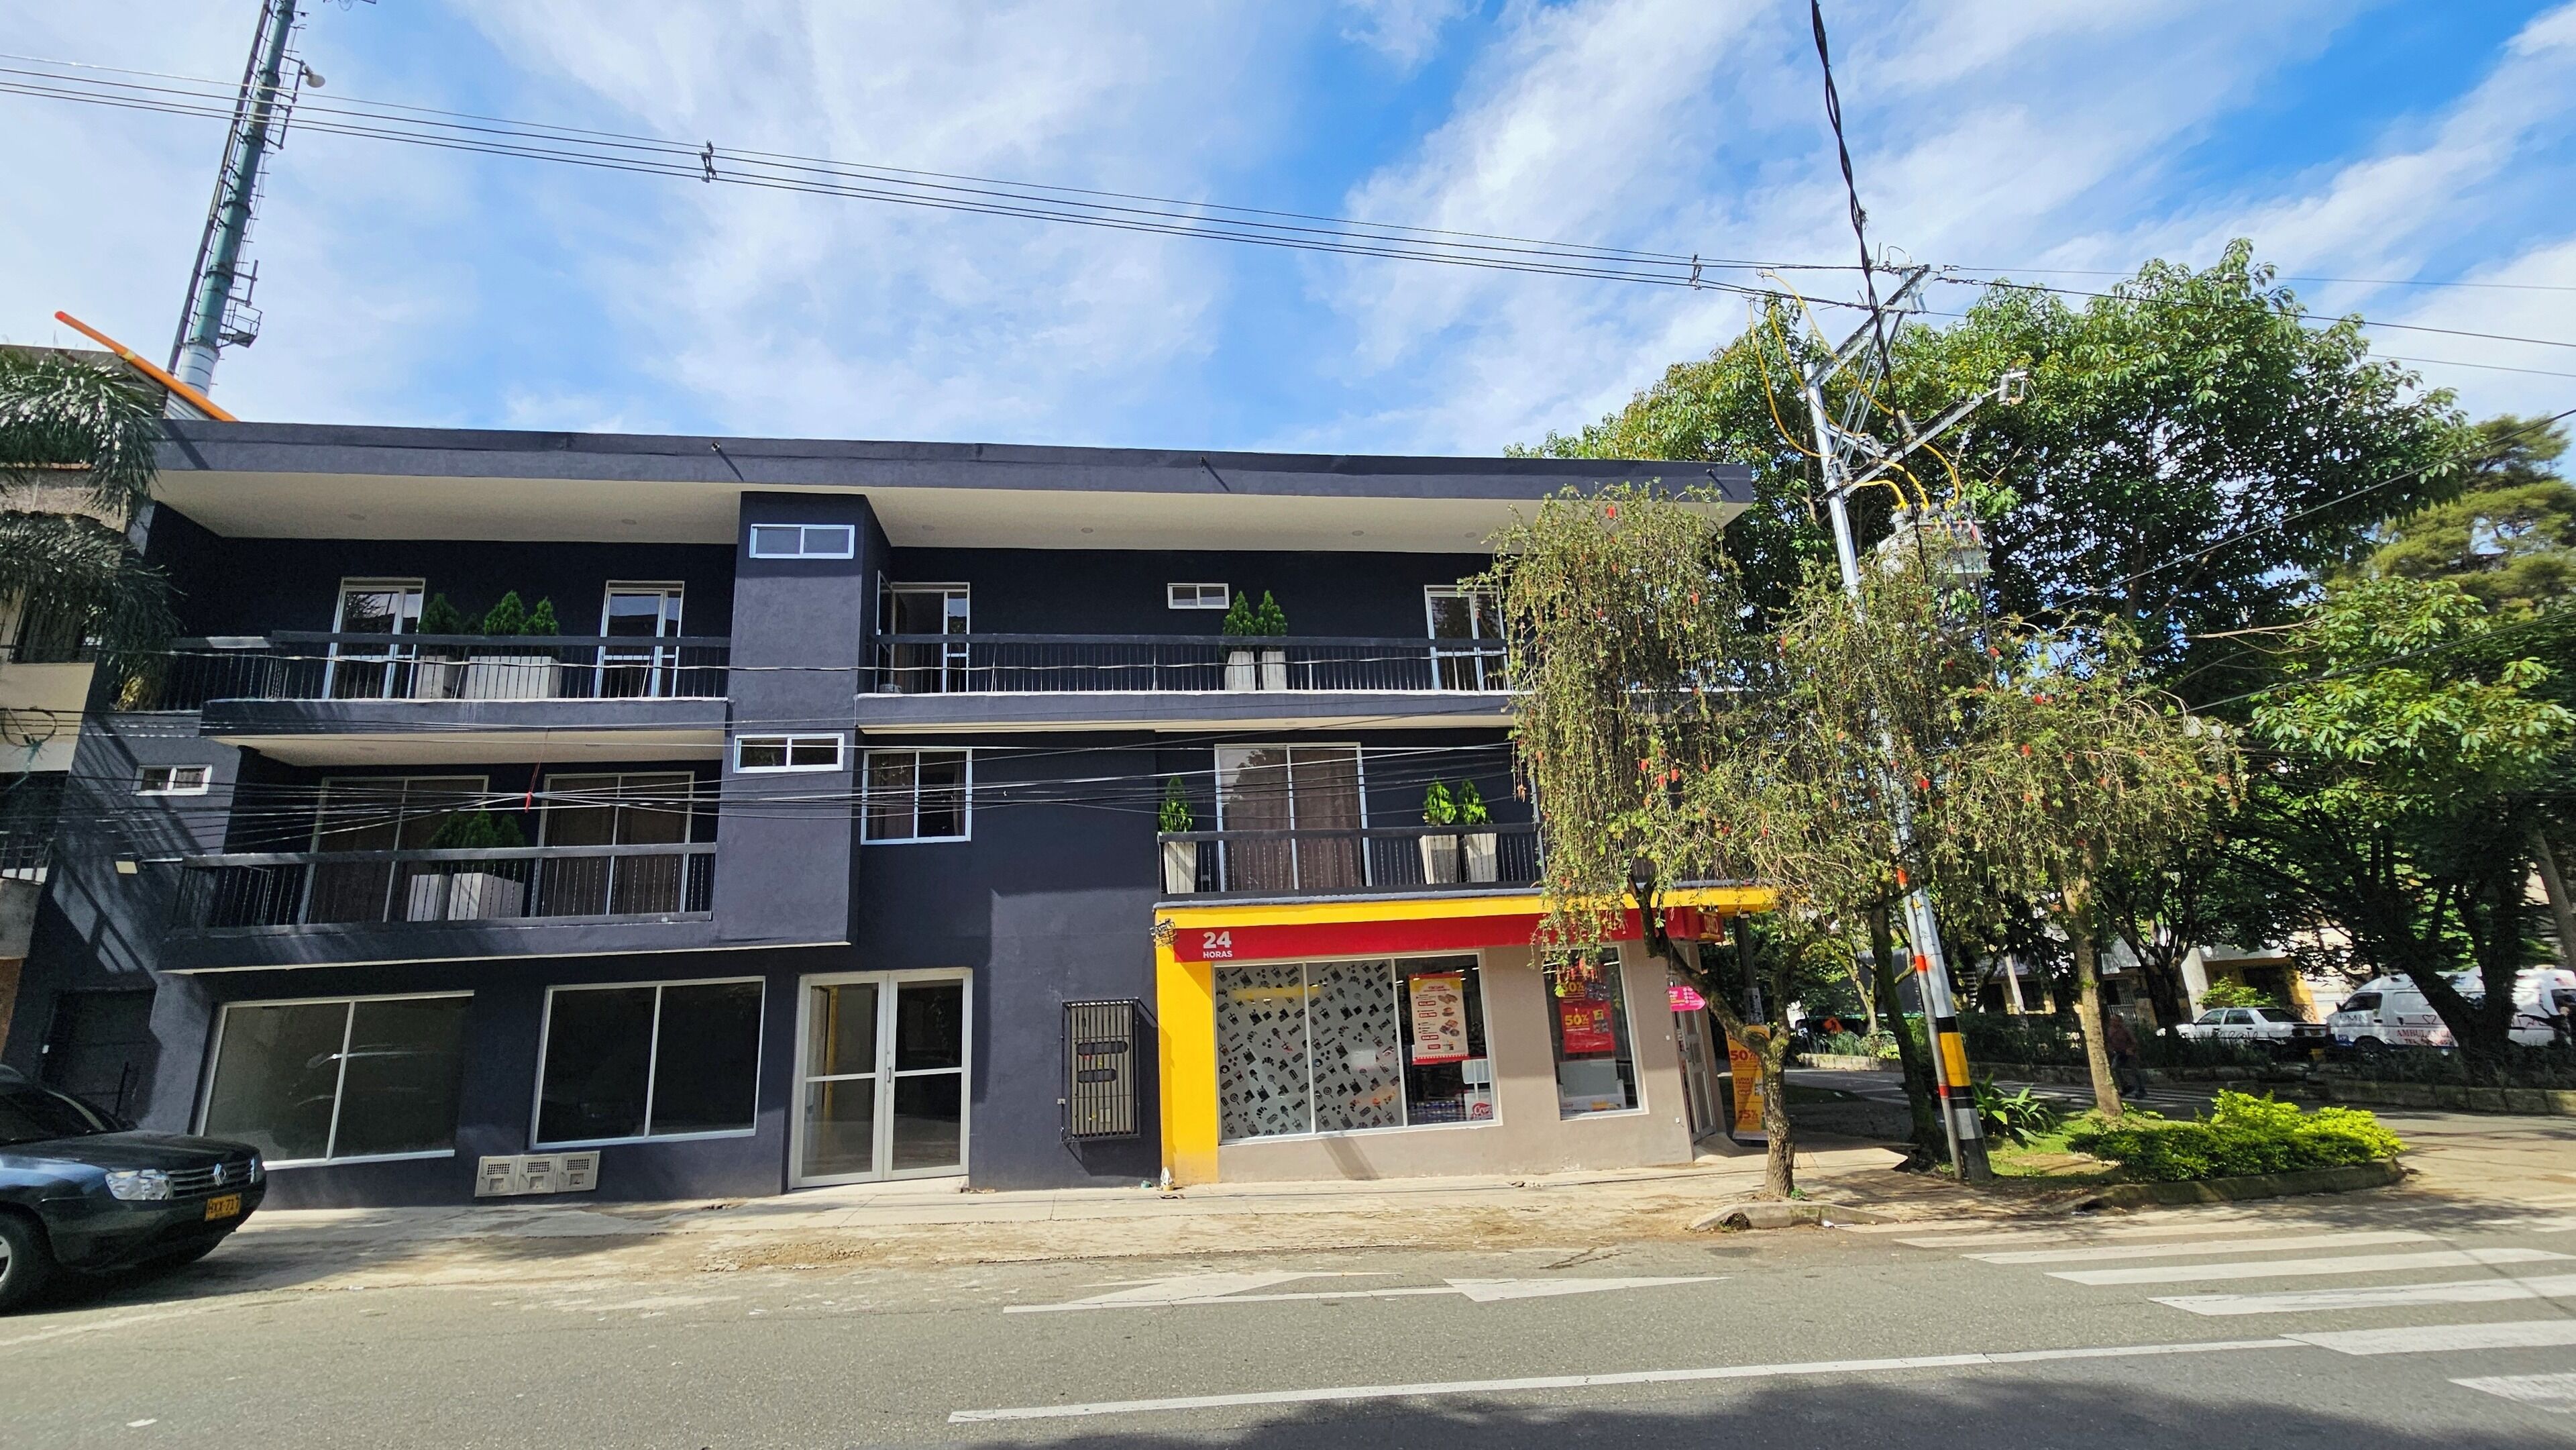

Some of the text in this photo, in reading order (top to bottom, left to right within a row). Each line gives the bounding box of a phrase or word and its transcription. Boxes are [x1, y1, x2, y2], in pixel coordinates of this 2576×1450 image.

[1203, 931, 1232, 949] 24
[1203, 950, 1233, 959] HORAS
[1565, 1014, 1589, 1026] 50%
